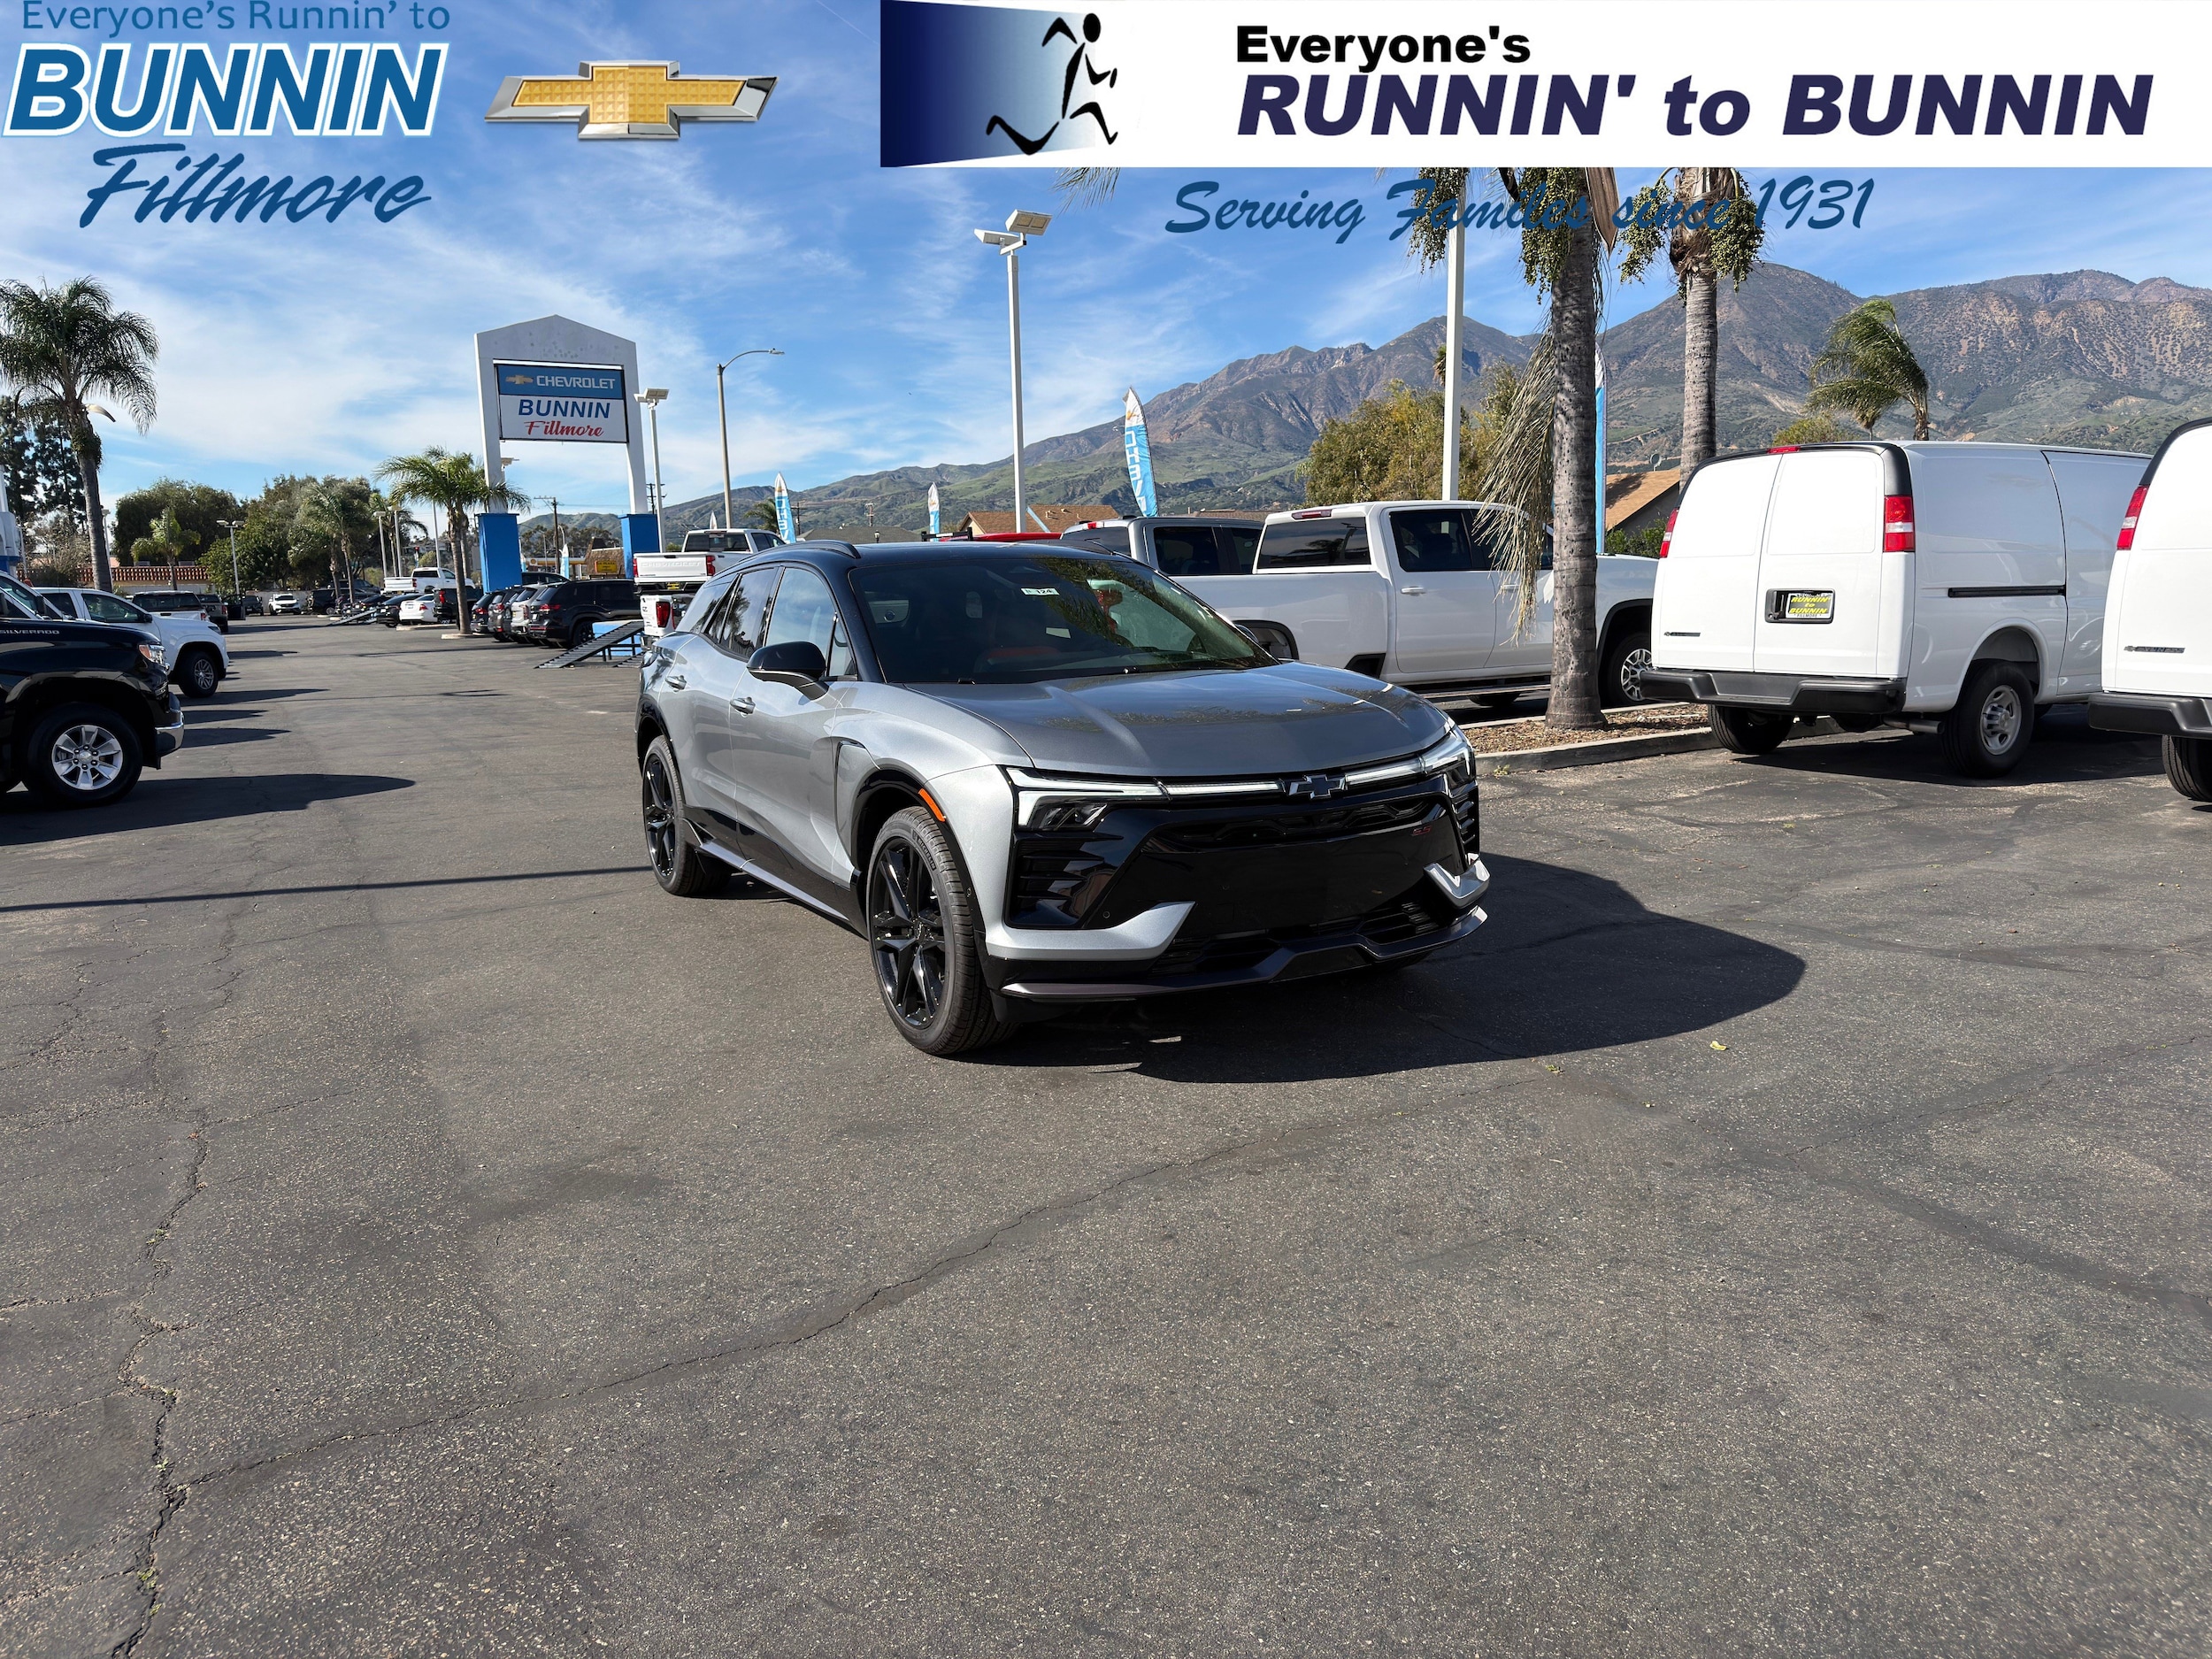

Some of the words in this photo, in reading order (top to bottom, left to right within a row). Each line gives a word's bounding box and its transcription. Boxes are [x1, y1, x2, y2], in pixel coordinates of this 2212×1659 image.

[536, 375, 616, 389] CHEVROLET
[518, 399, 611, 419] BUNNIN
[524, 420, 604, 437] Fillmore
